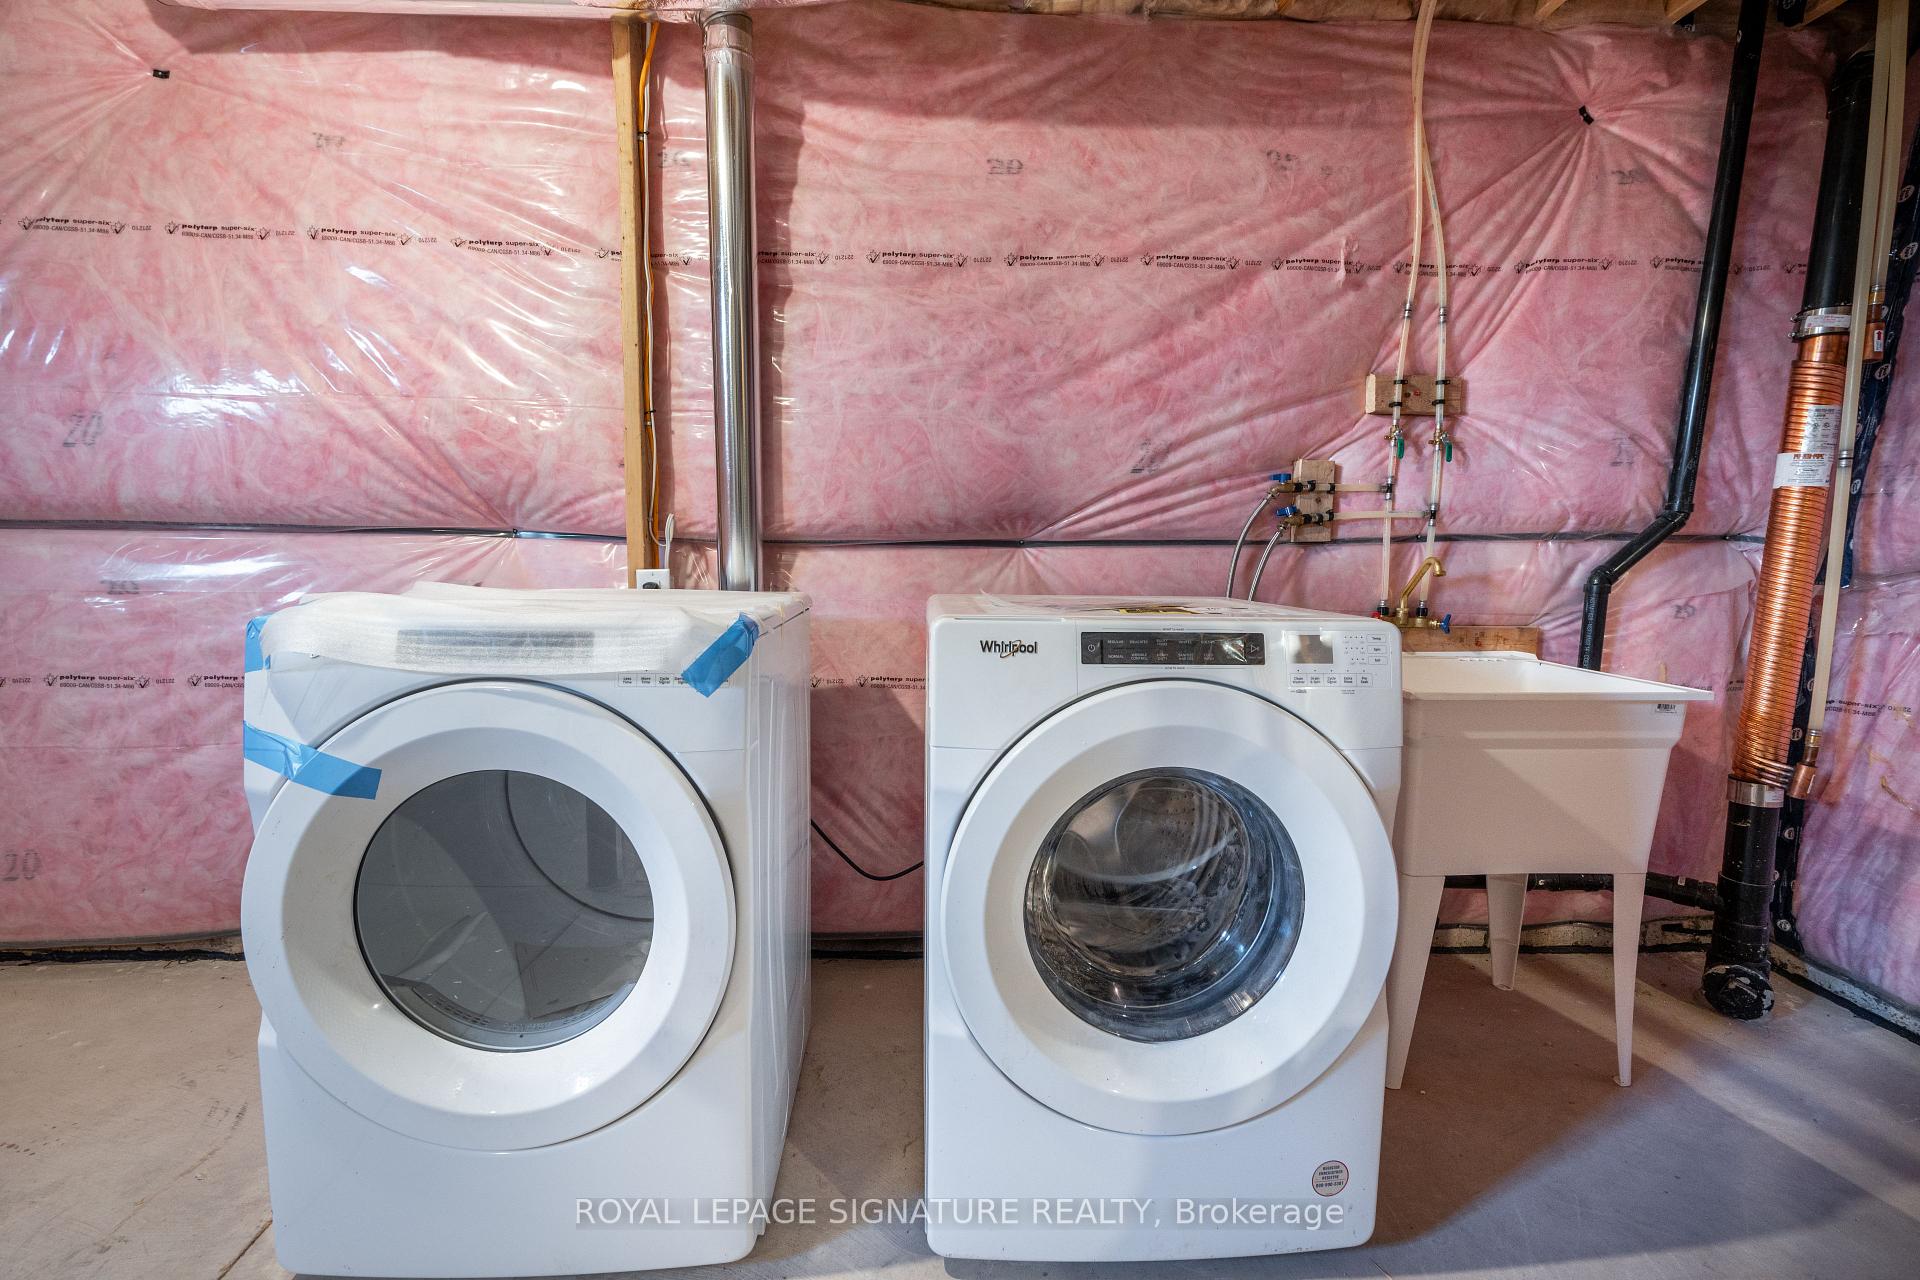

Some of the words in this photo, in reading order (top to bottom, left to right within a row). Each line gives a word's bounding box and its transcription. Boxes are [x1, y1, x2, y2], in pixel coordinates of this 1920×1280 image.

[73, 218, 111, 226] super-six
[321, 228, 358, 236] polytarp
[980, 639, 1038, 658] Whirlpool
[203, 674, 238, 682] polytarp
